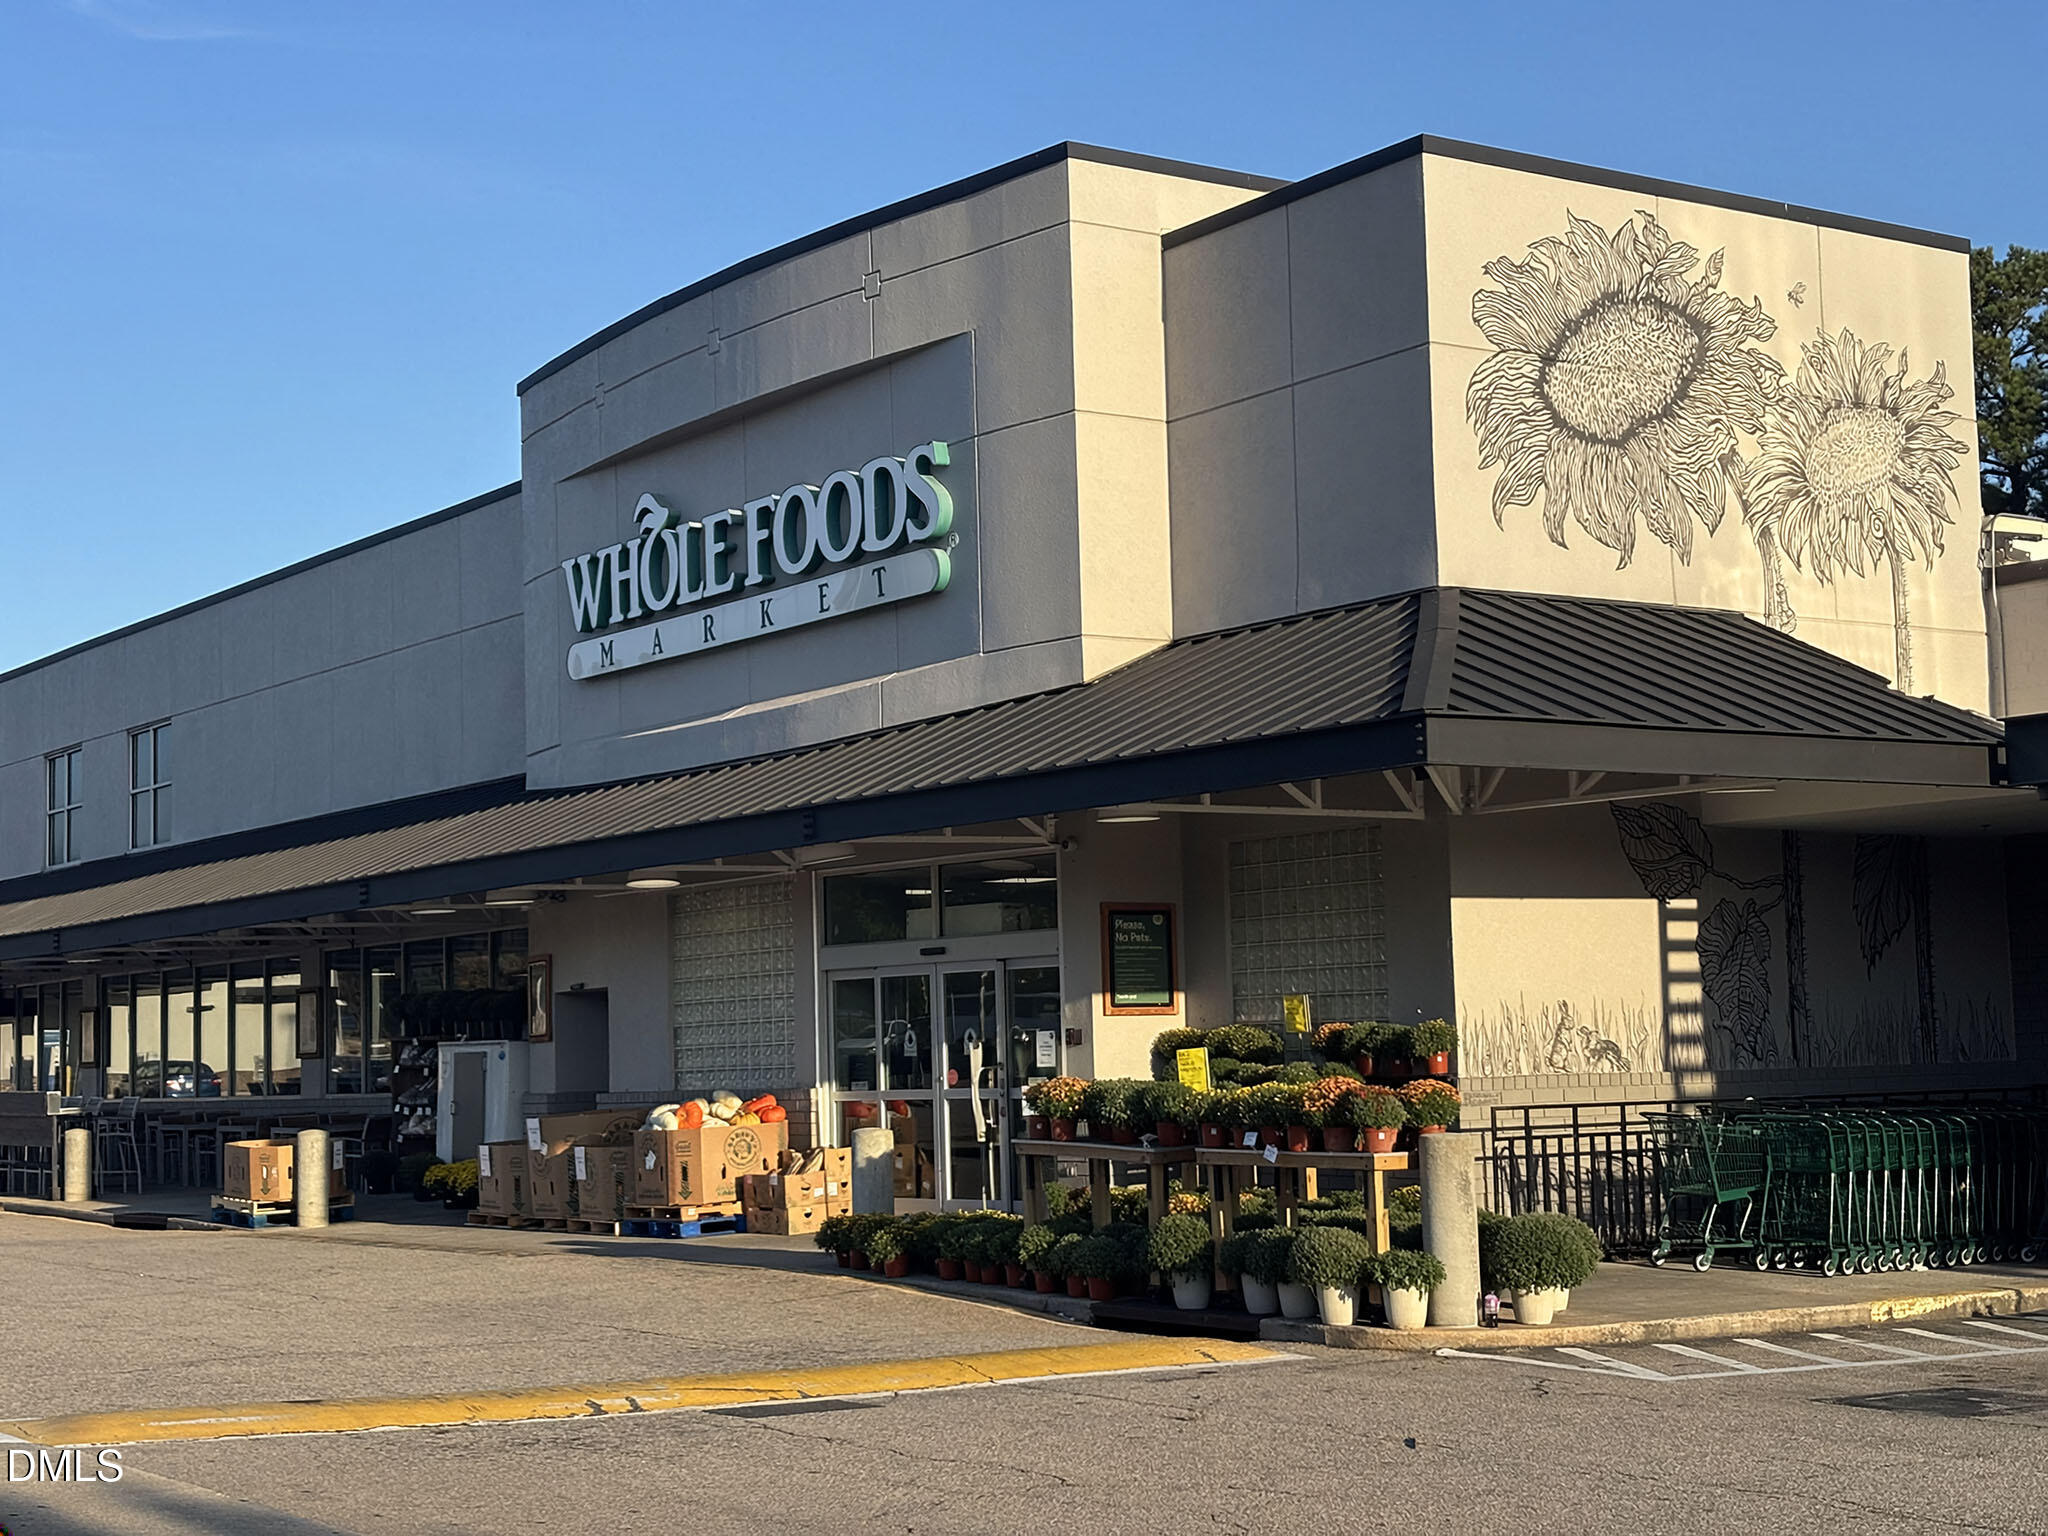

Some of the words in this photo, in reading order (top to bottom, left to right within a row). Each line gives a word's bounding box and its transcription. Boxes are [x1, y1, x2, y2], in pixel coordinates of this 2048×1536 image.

[561, 493, 745, 632] WHOLE
[744, 441, 953, 587] FOODS
[600, 566, 887, 669] MARKET
[1115, 932, 1129, 943] No
